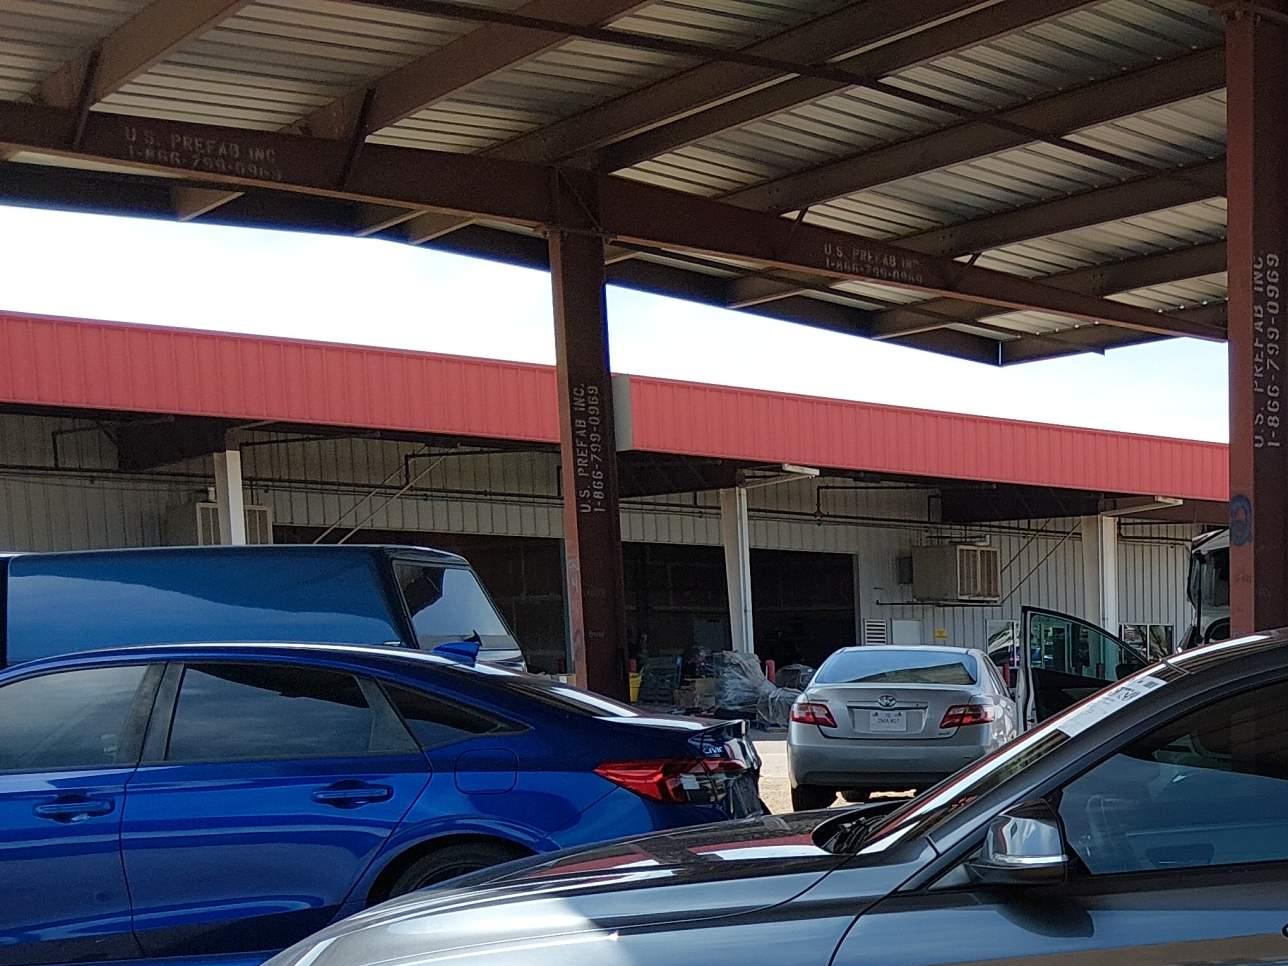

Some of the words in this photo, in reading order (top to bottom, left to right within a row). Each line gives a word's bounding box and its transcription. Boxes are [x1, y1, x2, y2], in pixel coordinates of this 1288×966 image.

[171, 133, 239, 158] PREFAB
[1267, 254, 1280, 446] 1-866-799-0969
[575, 419, 589, 477] PREFAB
[587, 385, 606, 512] 1-866-799-0969
